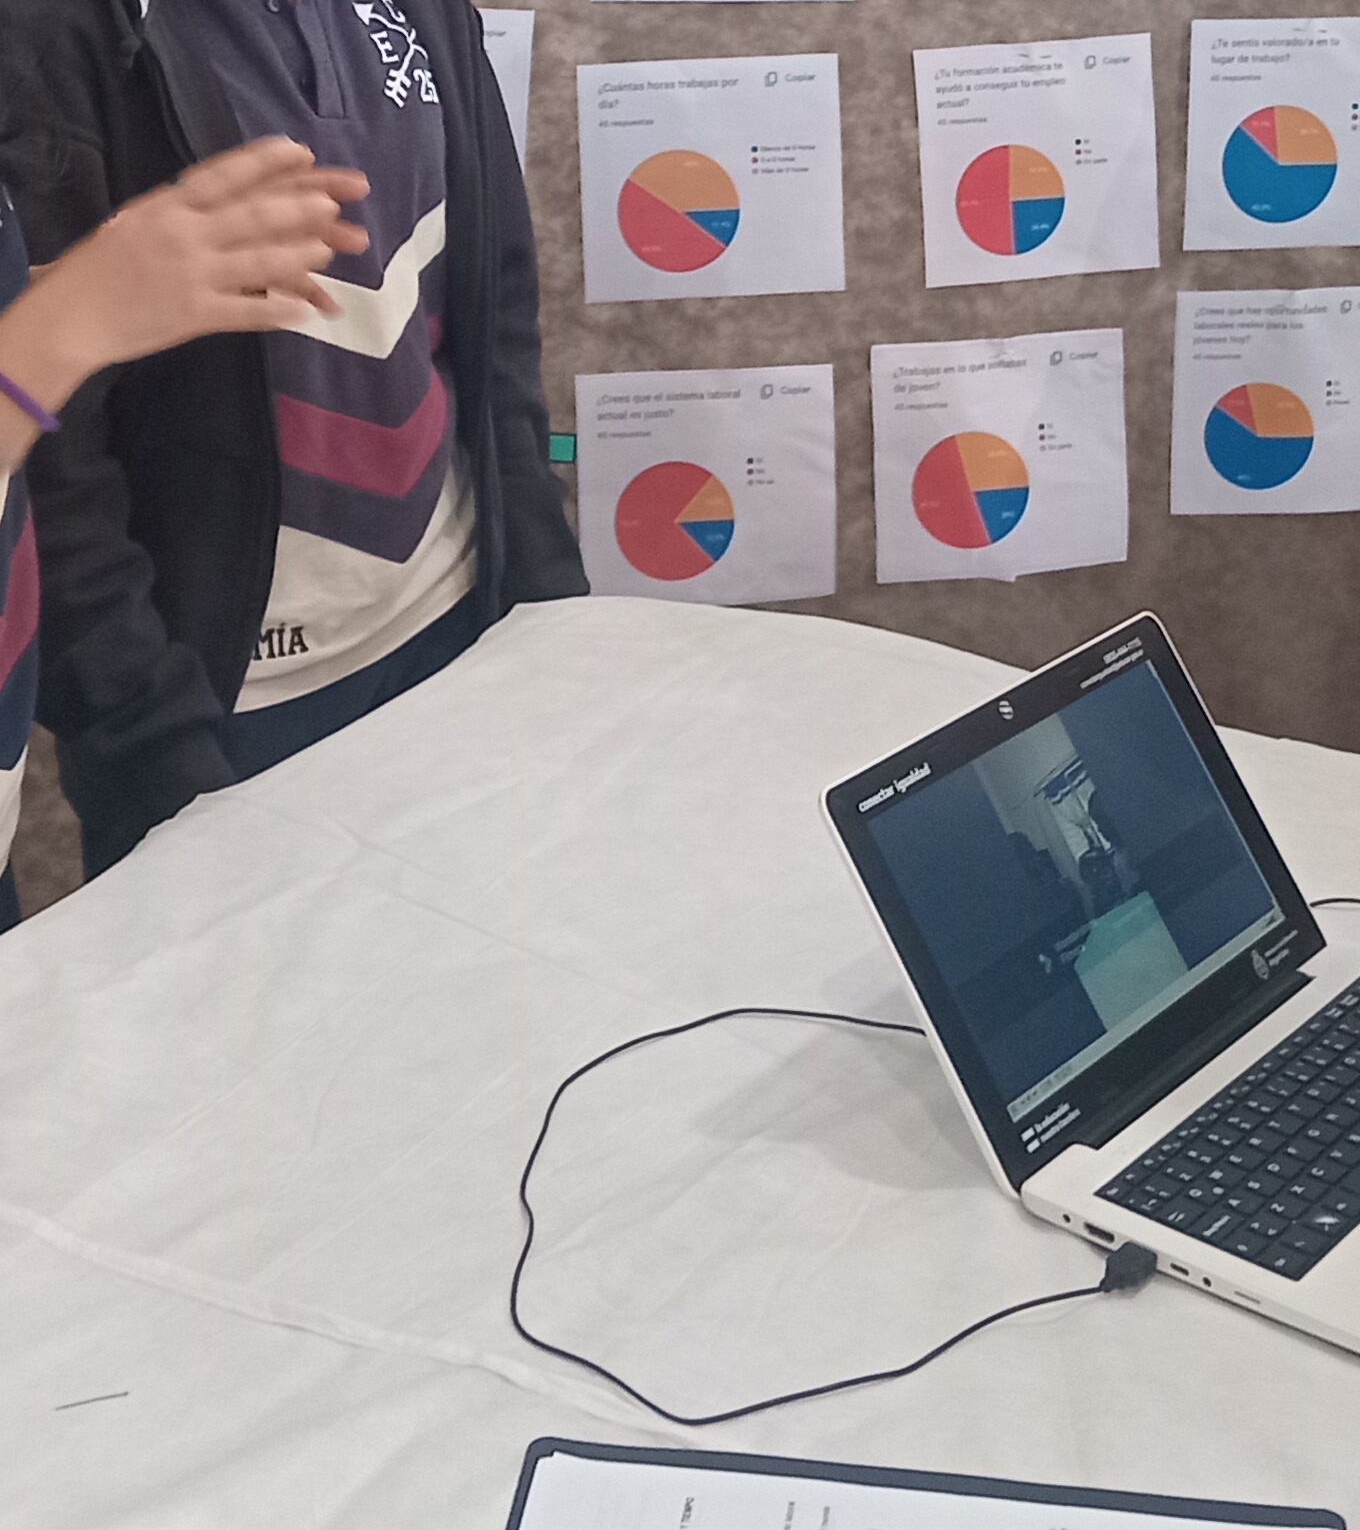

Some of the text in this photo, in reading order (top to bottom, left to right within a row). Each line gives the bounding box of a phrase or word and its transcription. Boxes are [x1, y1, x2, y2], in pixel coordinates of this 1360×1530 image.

[369, 30, 400, 64] E
[1211, 37, 1228, 50] ¿Te
[1262, 36, 1313, 48] valorado/a
[1316, 39, 1328, 47] en
[1330, 37, 1340, 47] tu
[1102, 55, 1131, 66] Copiar
[1211, 52, 1291, 66] lugar de trabajo?
[785, 72, 815, 83] Copiar
[934, 61, 1063, 80] ¿Tu formación académica te
[647, 79, 675, 91] horas
[678, 77, 719, 90] trabajas
[721, 77, 739, 90] por
[935, 82, 963, 95] ayudó
[973, 80, 1018, 93] conseguir
[1020, 79, 1030, 89] tu
[1032, 76, 1066, 88] empleo
[936, 97, 970, 110] actual?
[1227, 306, 1244, 317] que
[1246, 306, 1262, 317] hay
[1193, 321, 1304, 332] laborales reales para los
[1069, 350, 1098, 361] Copiar
[892, 365, 941, 379] ¿Trabajas
[943, 365, 955, 374] en
[957, 363, 967, 373] lo
[968, 363, 986, 374] que
[780, 384, 811, 396] Copiar
[893, 380, 941, 394] de joven?
[633, 393, 651, 405] que
[653, 391, 663, 402] el
[665, 391, 704, 402] sistema
[707, 388, 741, 400] laboral
[597, 410, 628, 421] actual
[643, 407, 674, 421] justo?
